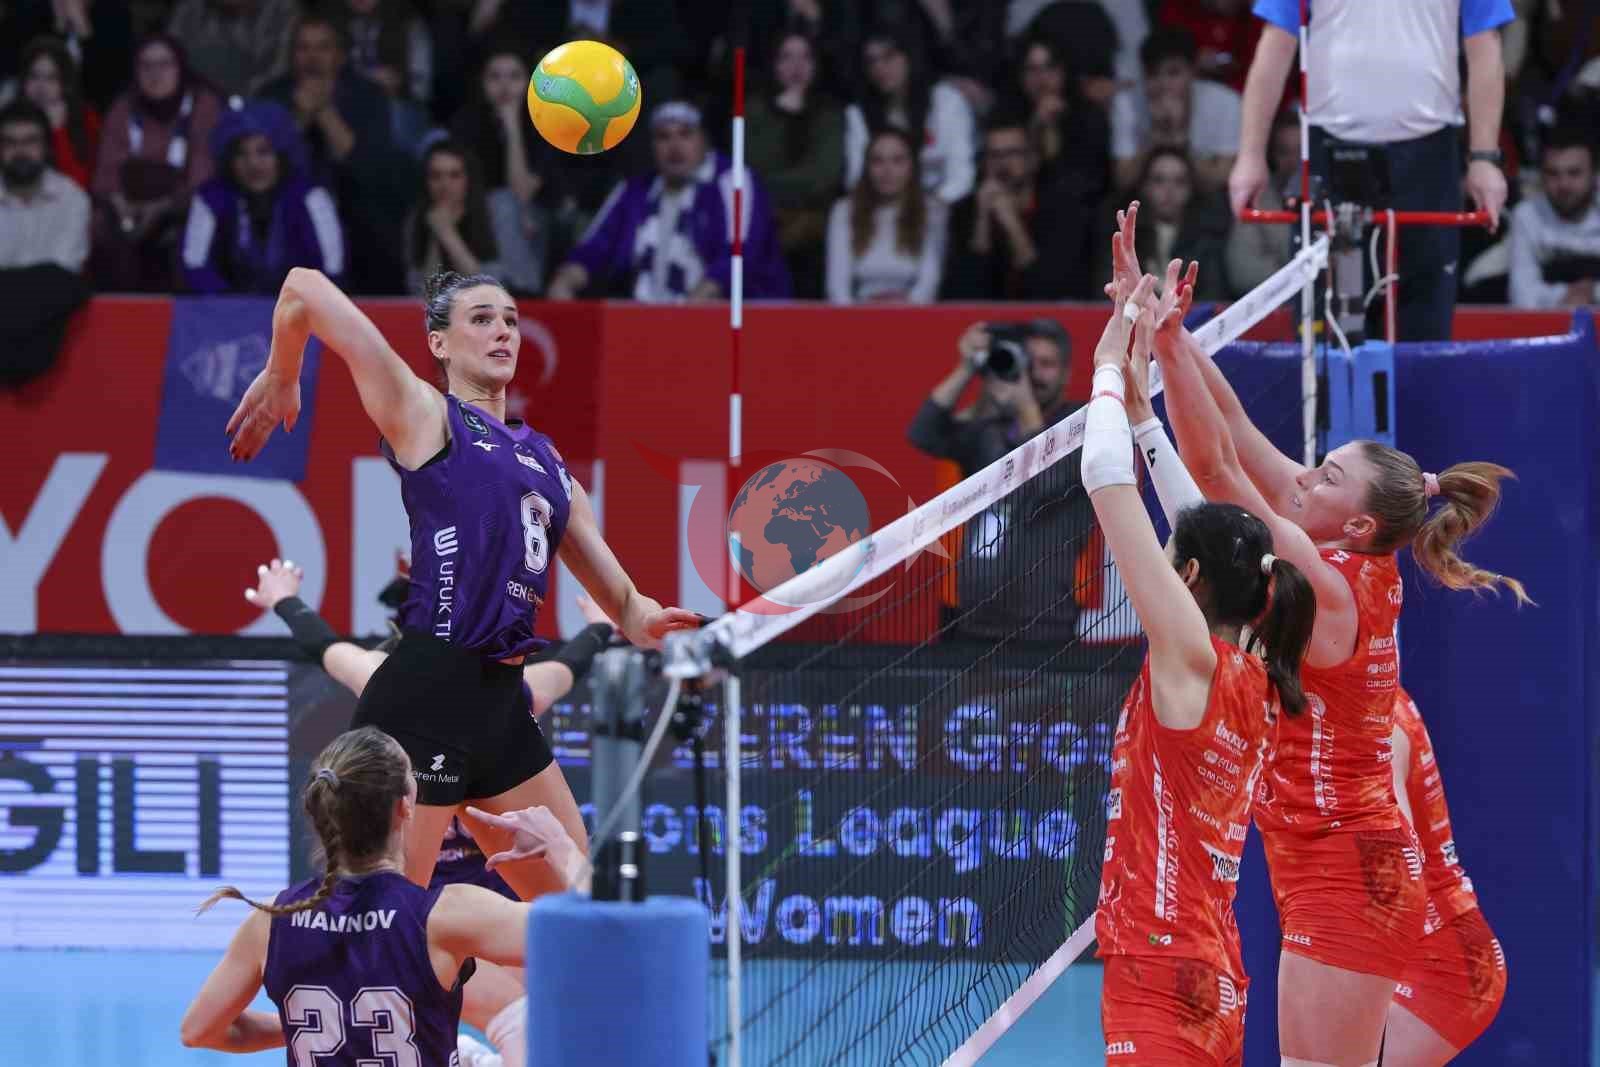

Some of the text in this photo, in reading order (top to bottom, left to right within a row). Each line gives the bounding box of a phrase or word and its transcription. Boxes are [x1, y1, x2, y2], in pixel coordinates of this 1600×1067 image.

[520, 491, 553, 575] 8
[435, 560, 454, 641] UFUK TI
[795, 789, 1079, 874] League
[290, 909, 397, 933] MALINOV
[693, 877, 984, 947] Women
[283, 984, 422, 1067] 23
